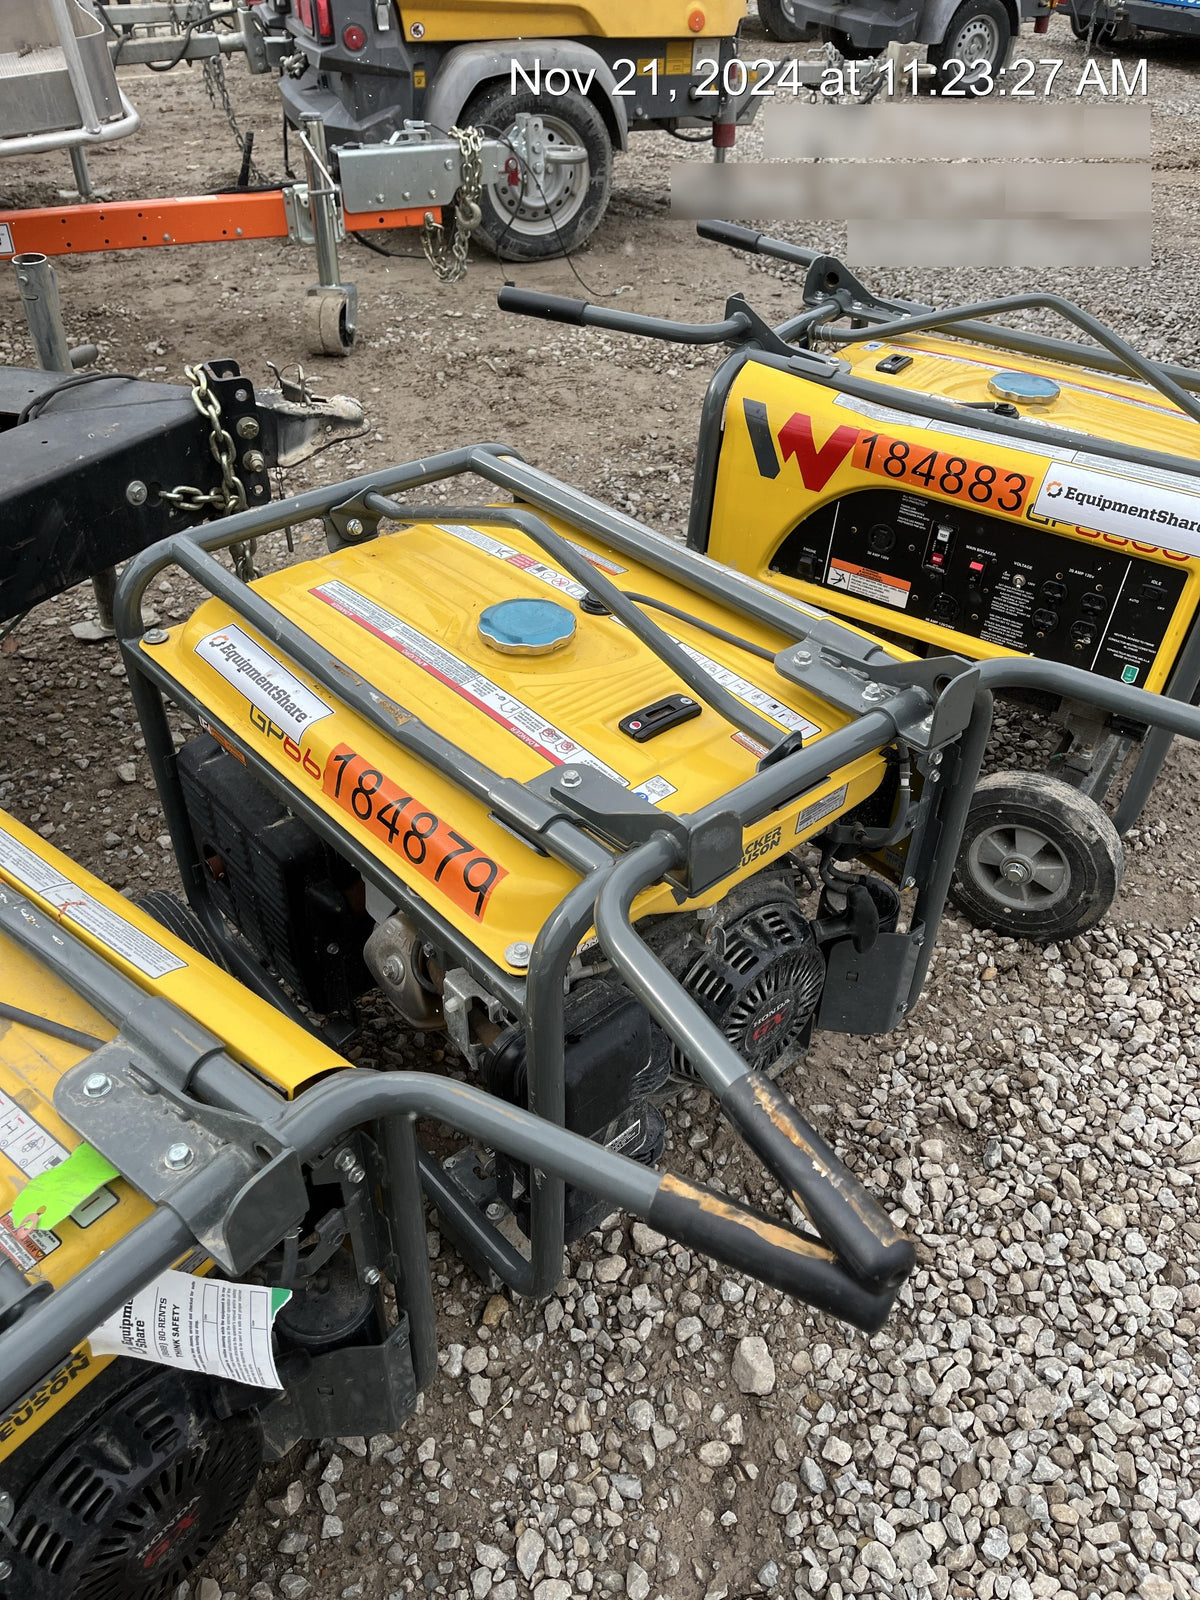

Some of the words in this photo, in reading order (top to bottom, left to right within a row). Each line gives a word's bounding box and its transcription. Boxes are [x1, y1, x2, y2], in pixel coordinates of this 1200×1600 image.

[861, 434, 1027, 512] 184883
[965, 544, 976, 552] MAIN
[976, 547, 997, 557] BREAKER
[1013, 560, 1033, 571] VOLTAGE
[219, 642, 309, 725] EquipmentShare
[509, 726, 535, 747] DANGER
[333, 753, 500, 917] 184879
[738, 836, 781, 868] USON
[752, 998, 790, 1028] HONDA
[135, 1320, 148, 1349] Share
[172, 1304, 180, 1338] SAFETY
[172, 1339, 183, 1358] THINK
